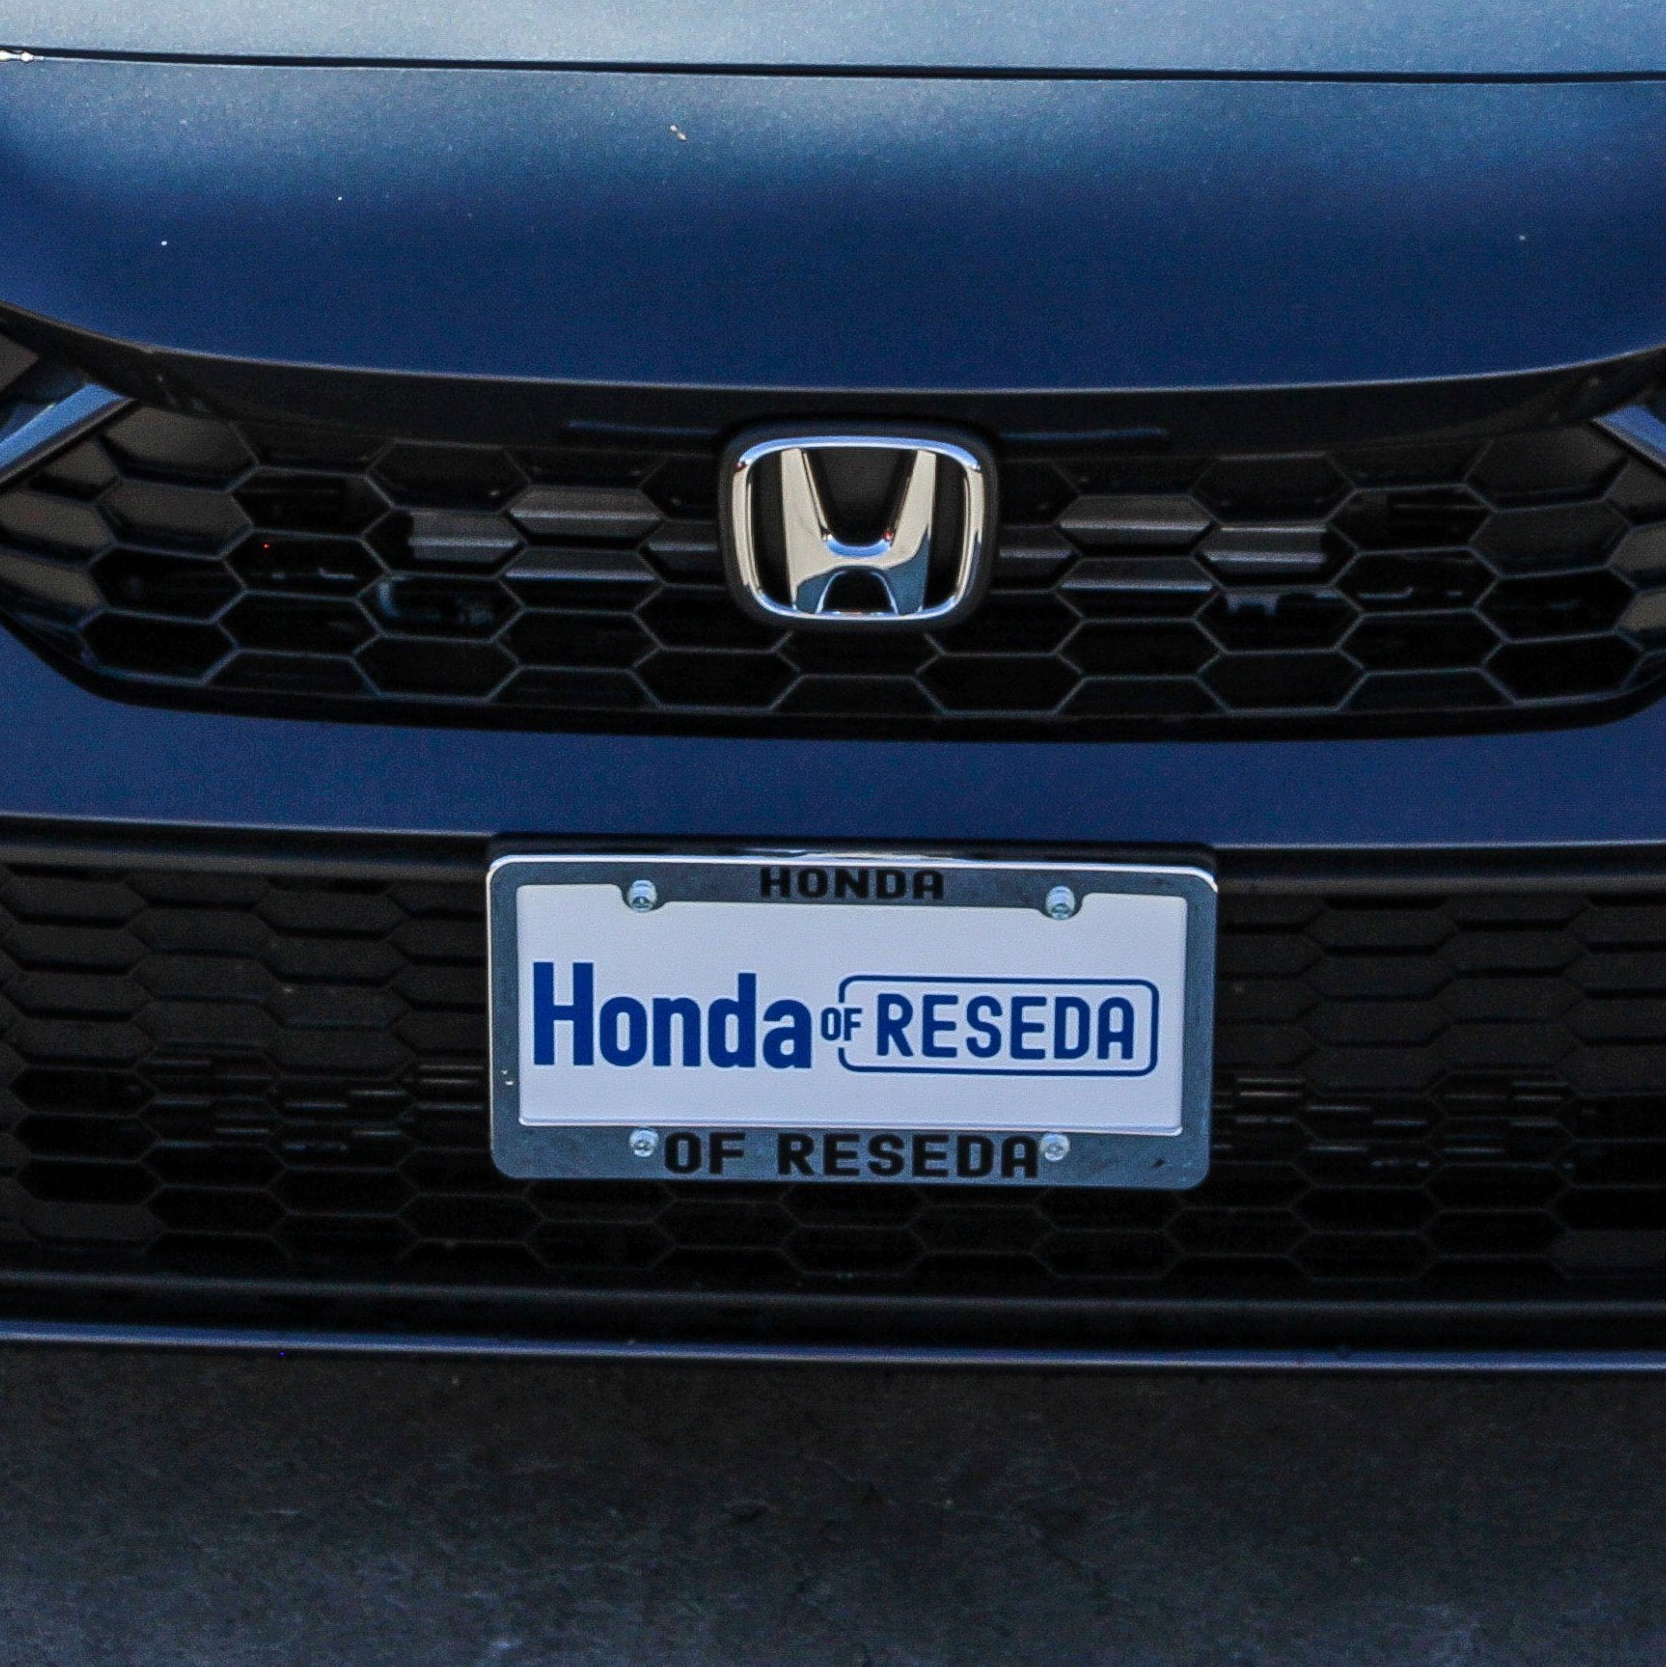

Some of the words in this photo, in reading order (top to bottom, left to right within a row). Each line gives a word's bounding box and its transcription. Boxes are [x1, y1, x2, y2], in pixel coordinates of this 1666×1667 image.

[761, 867, 944, 900] HONDA
[533, 962, 812, 1069] Honda
[821, 1007, 861, 1041] OF
[876, 993, 1134, 1060] RESEDA
[664, 1131, 746, 1176] OF
[778, 1132, 1039, 1178] RESEDA
